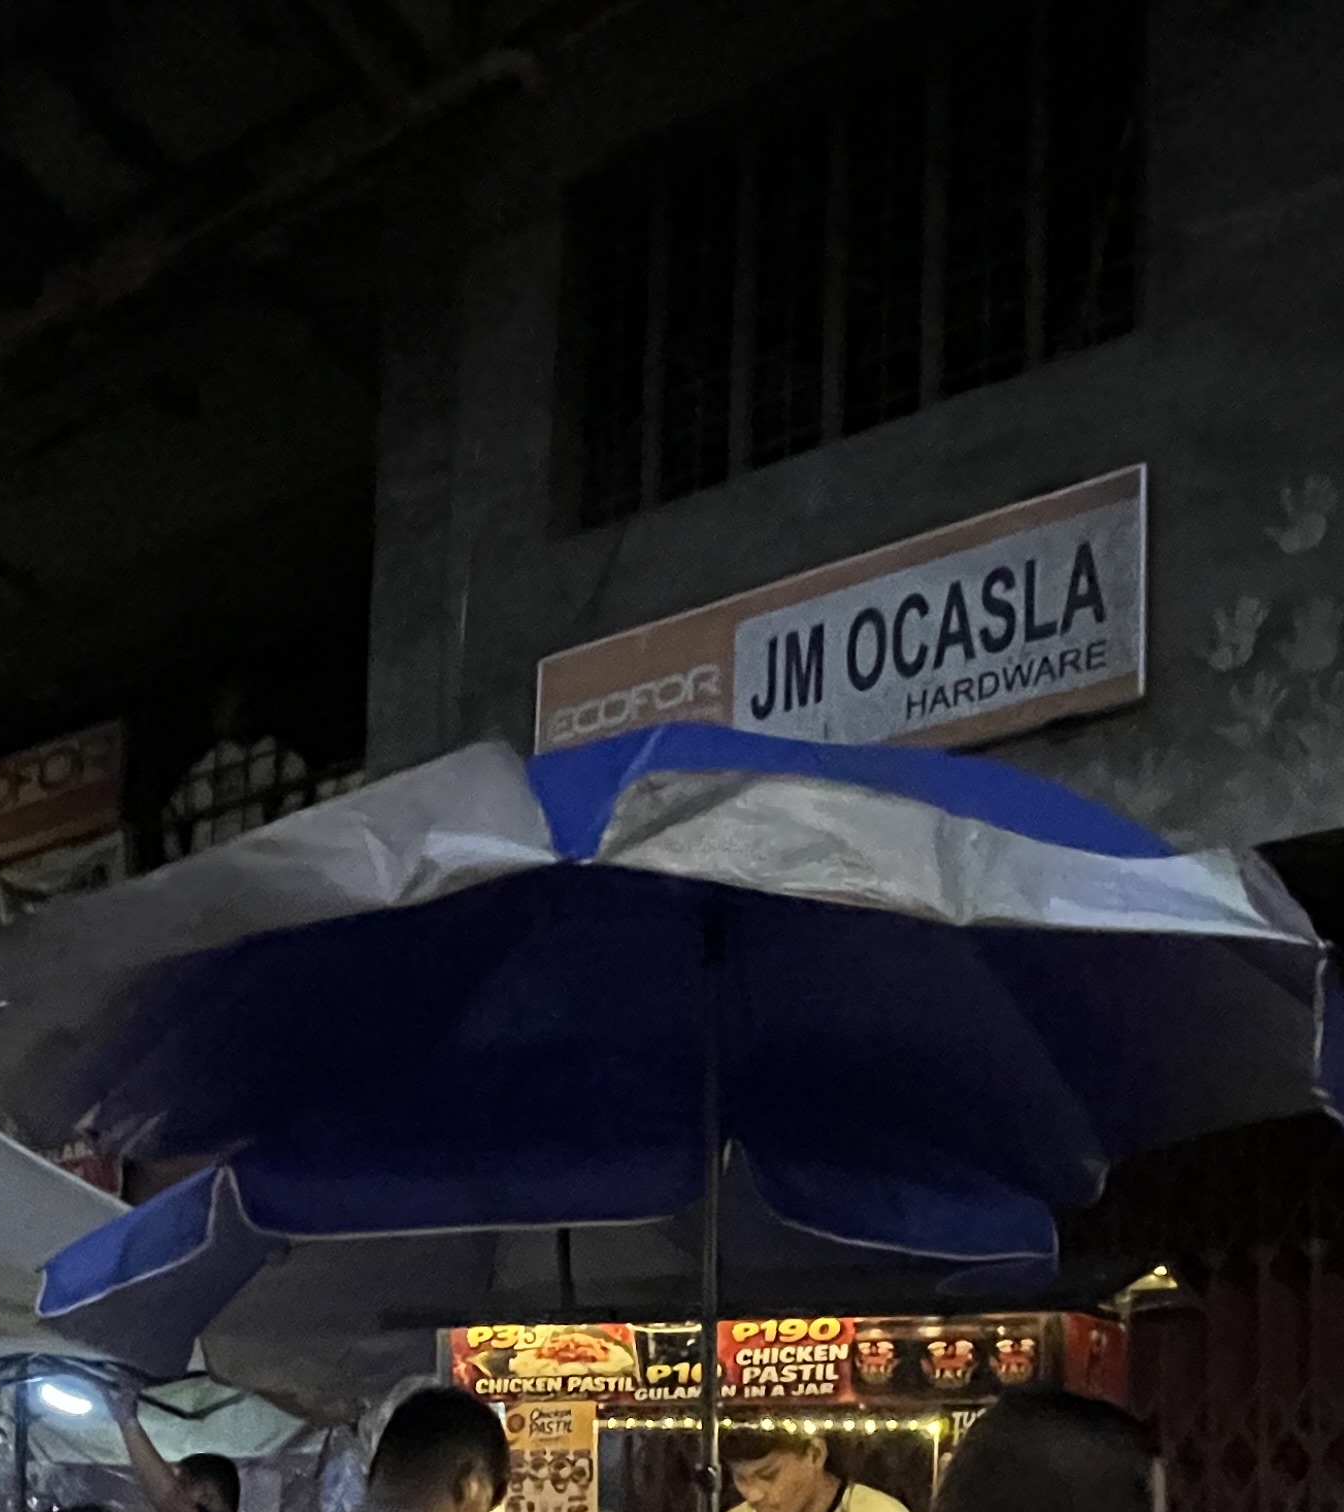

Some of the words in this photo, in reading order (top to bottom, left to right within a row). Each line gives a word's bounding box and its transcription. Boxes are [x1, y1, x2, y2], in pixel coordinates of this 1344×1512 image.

[750, 624, 825, 720] JM
[846, 541, 1106, 692] OCASLA
[905, 640, 1107, 720] HARDWARE
[732, 1317, 840, 1343] P190
[736, 1343, 849, 1366] CHICKEN
[742, 1363, 839, 1384] PASTIL
[476, 1376, 562, 1394] CHICKEN
[567, 1376, 635, 1392] PASTIL
[634, 1385, 736, 1400] GULAMN
[744, 1385, 765, 1398] IN
[770, 1385, 785, 1397] A
[791, 1383, 834, 1396] JAR
